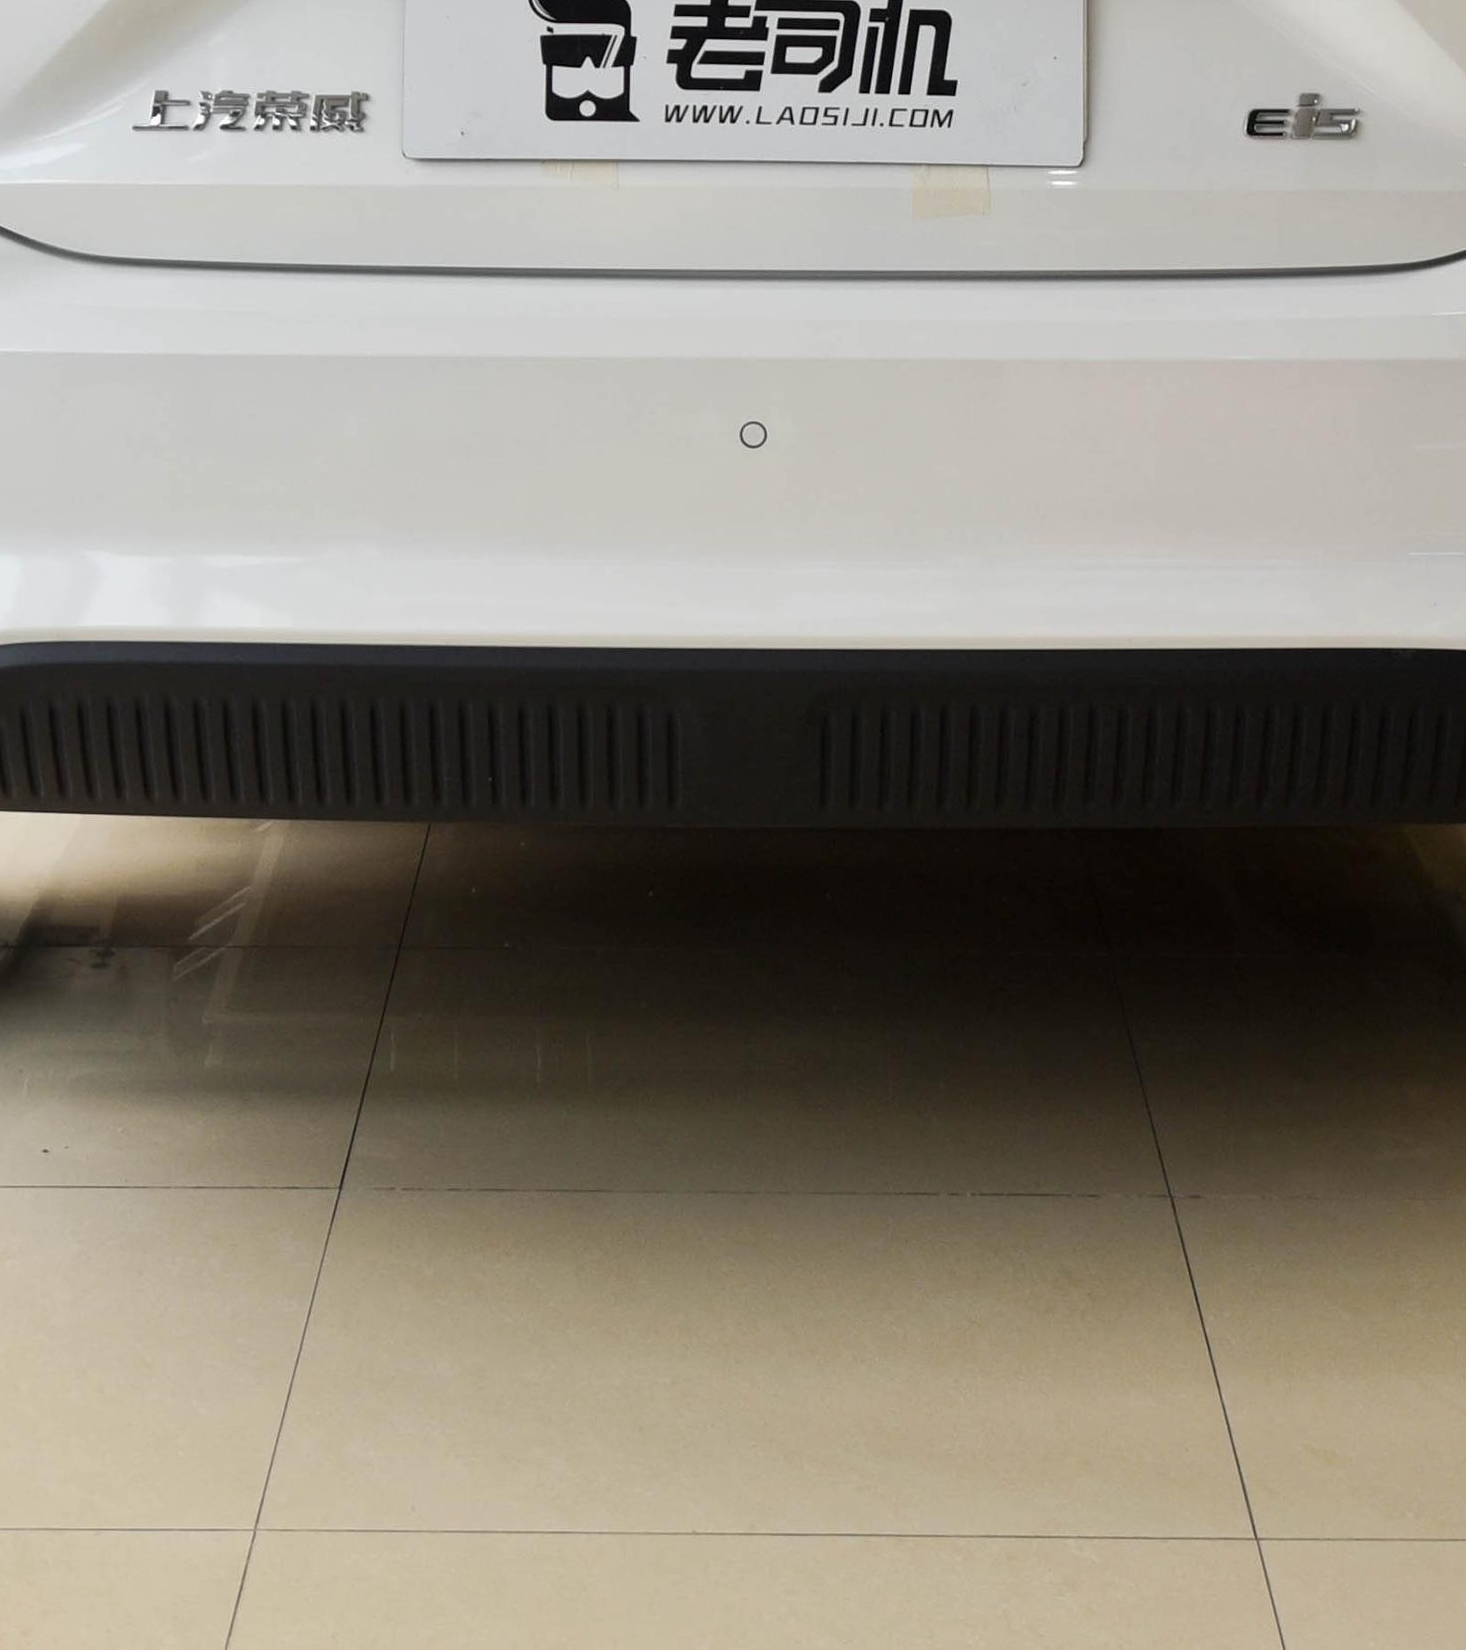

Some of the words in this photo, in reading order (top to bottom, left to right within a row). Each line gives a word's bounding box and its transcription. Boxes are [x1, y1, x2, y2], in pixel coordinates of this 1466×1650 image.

[132, 90, 370, 132] 上汽荣威
[663, 104, 955, 128] WWW.LAOSIJI.COM
